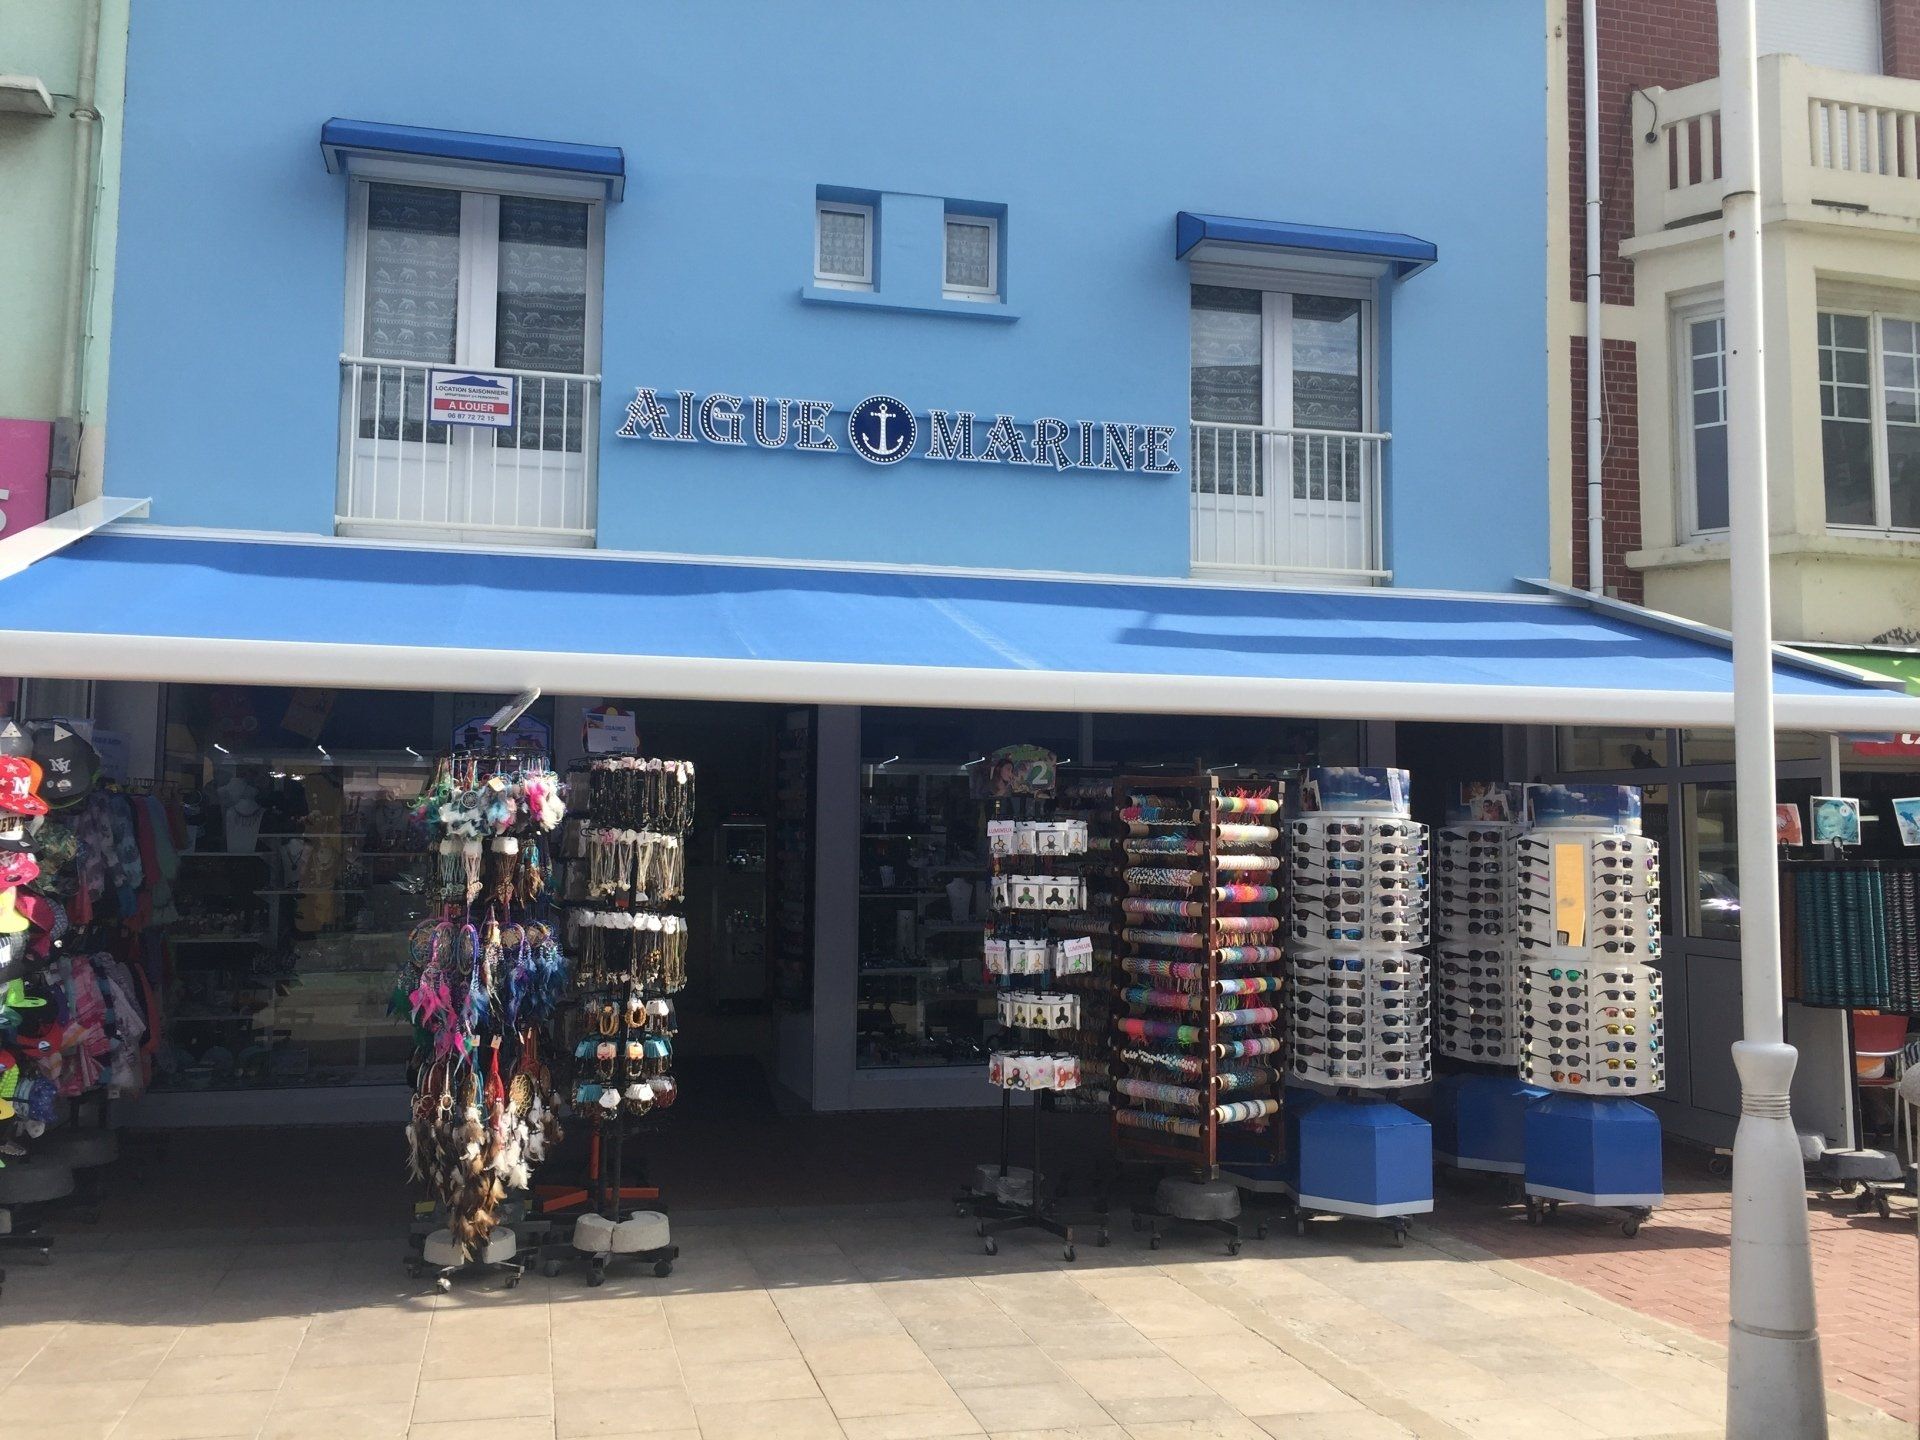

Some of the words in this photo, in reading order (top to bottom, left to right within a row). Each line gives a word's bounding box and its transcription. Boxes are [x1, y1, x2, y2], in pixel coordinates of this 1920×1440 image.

[435, 385, 467, 393] LOCATION
[449, 401, 456, 409] A
[459, 402, 495, 412] LOUER
[616, 387, 839, 452] AIGUE
[925, 408, 1182, 474] MARINE
[1032, 761, 1048, 785] 2
[0, 816, 18, 833] EW
